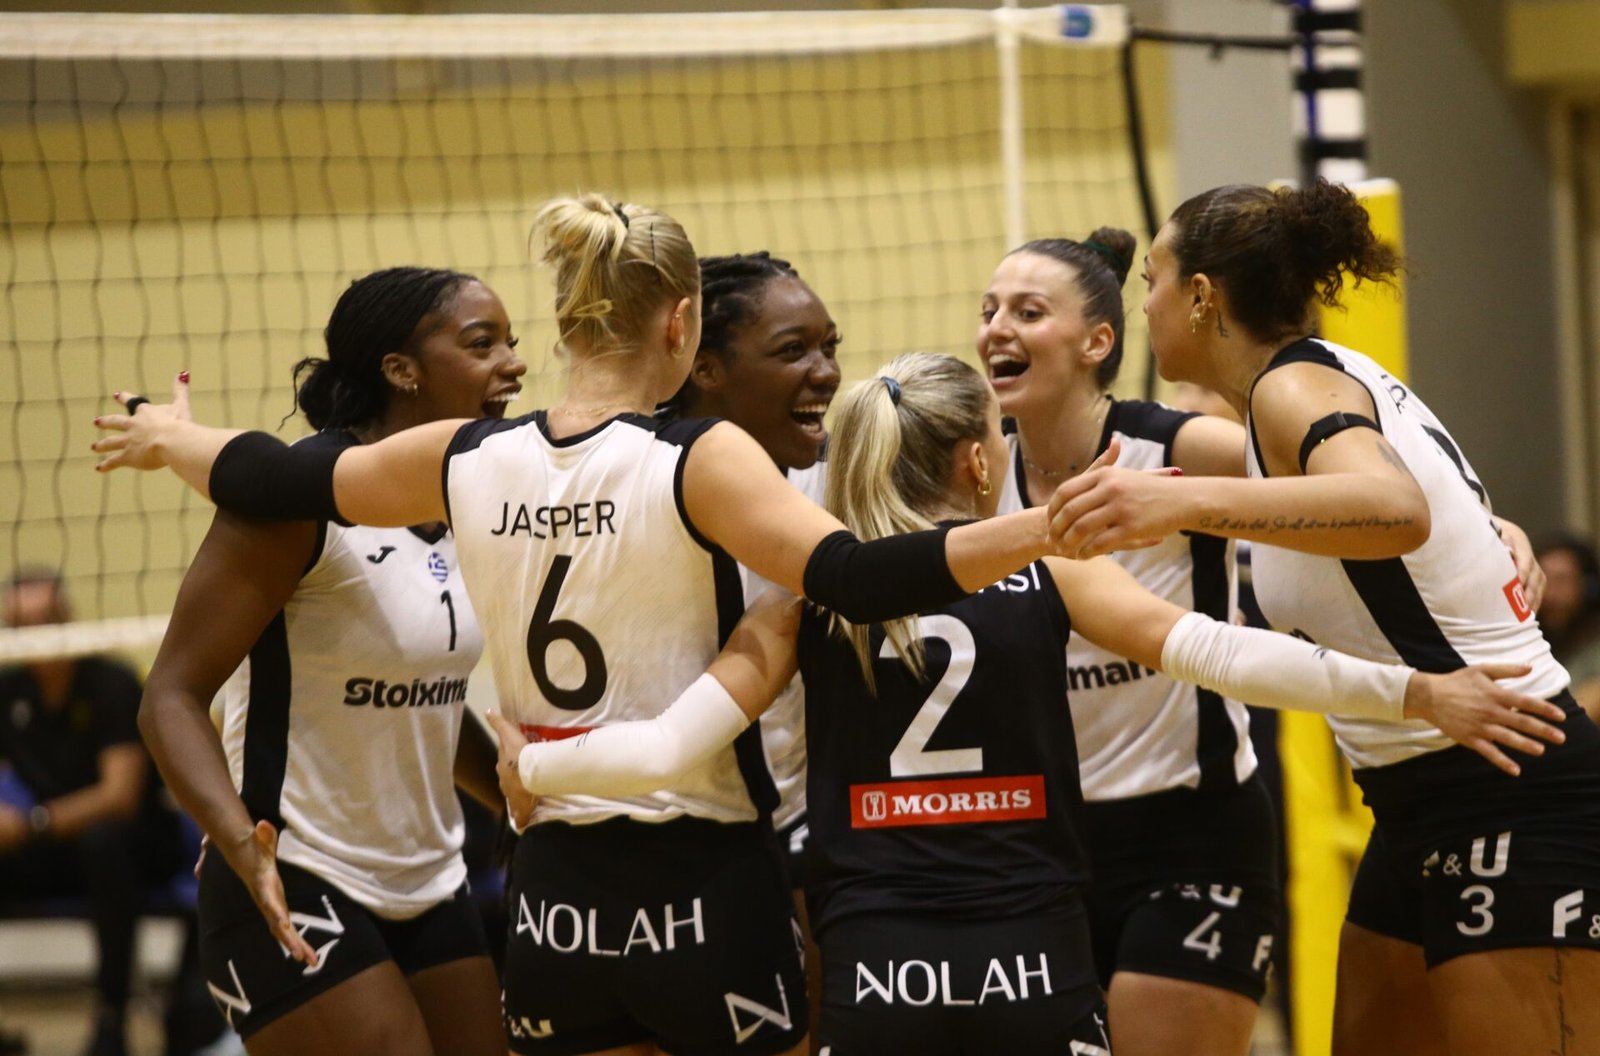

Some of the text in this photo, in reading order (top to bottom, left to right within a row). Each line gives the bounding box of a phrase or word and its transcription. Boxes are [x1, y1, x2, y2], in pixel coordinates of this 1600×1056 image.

[491, 500, 615, 539] JASPER
[440, 590, 457, 652] 1
[527, 555, 608, 710] 6
[878, 614, 984, 777] 2
[892, 789, 1032, 815] MORRIS
[516, 892, 705, 956] NOLAH
[1182, 911, 1222, 959] 4
[1456, 884, 1495, 936] 3
[856, 953, 1053, 1006] NOLAH
